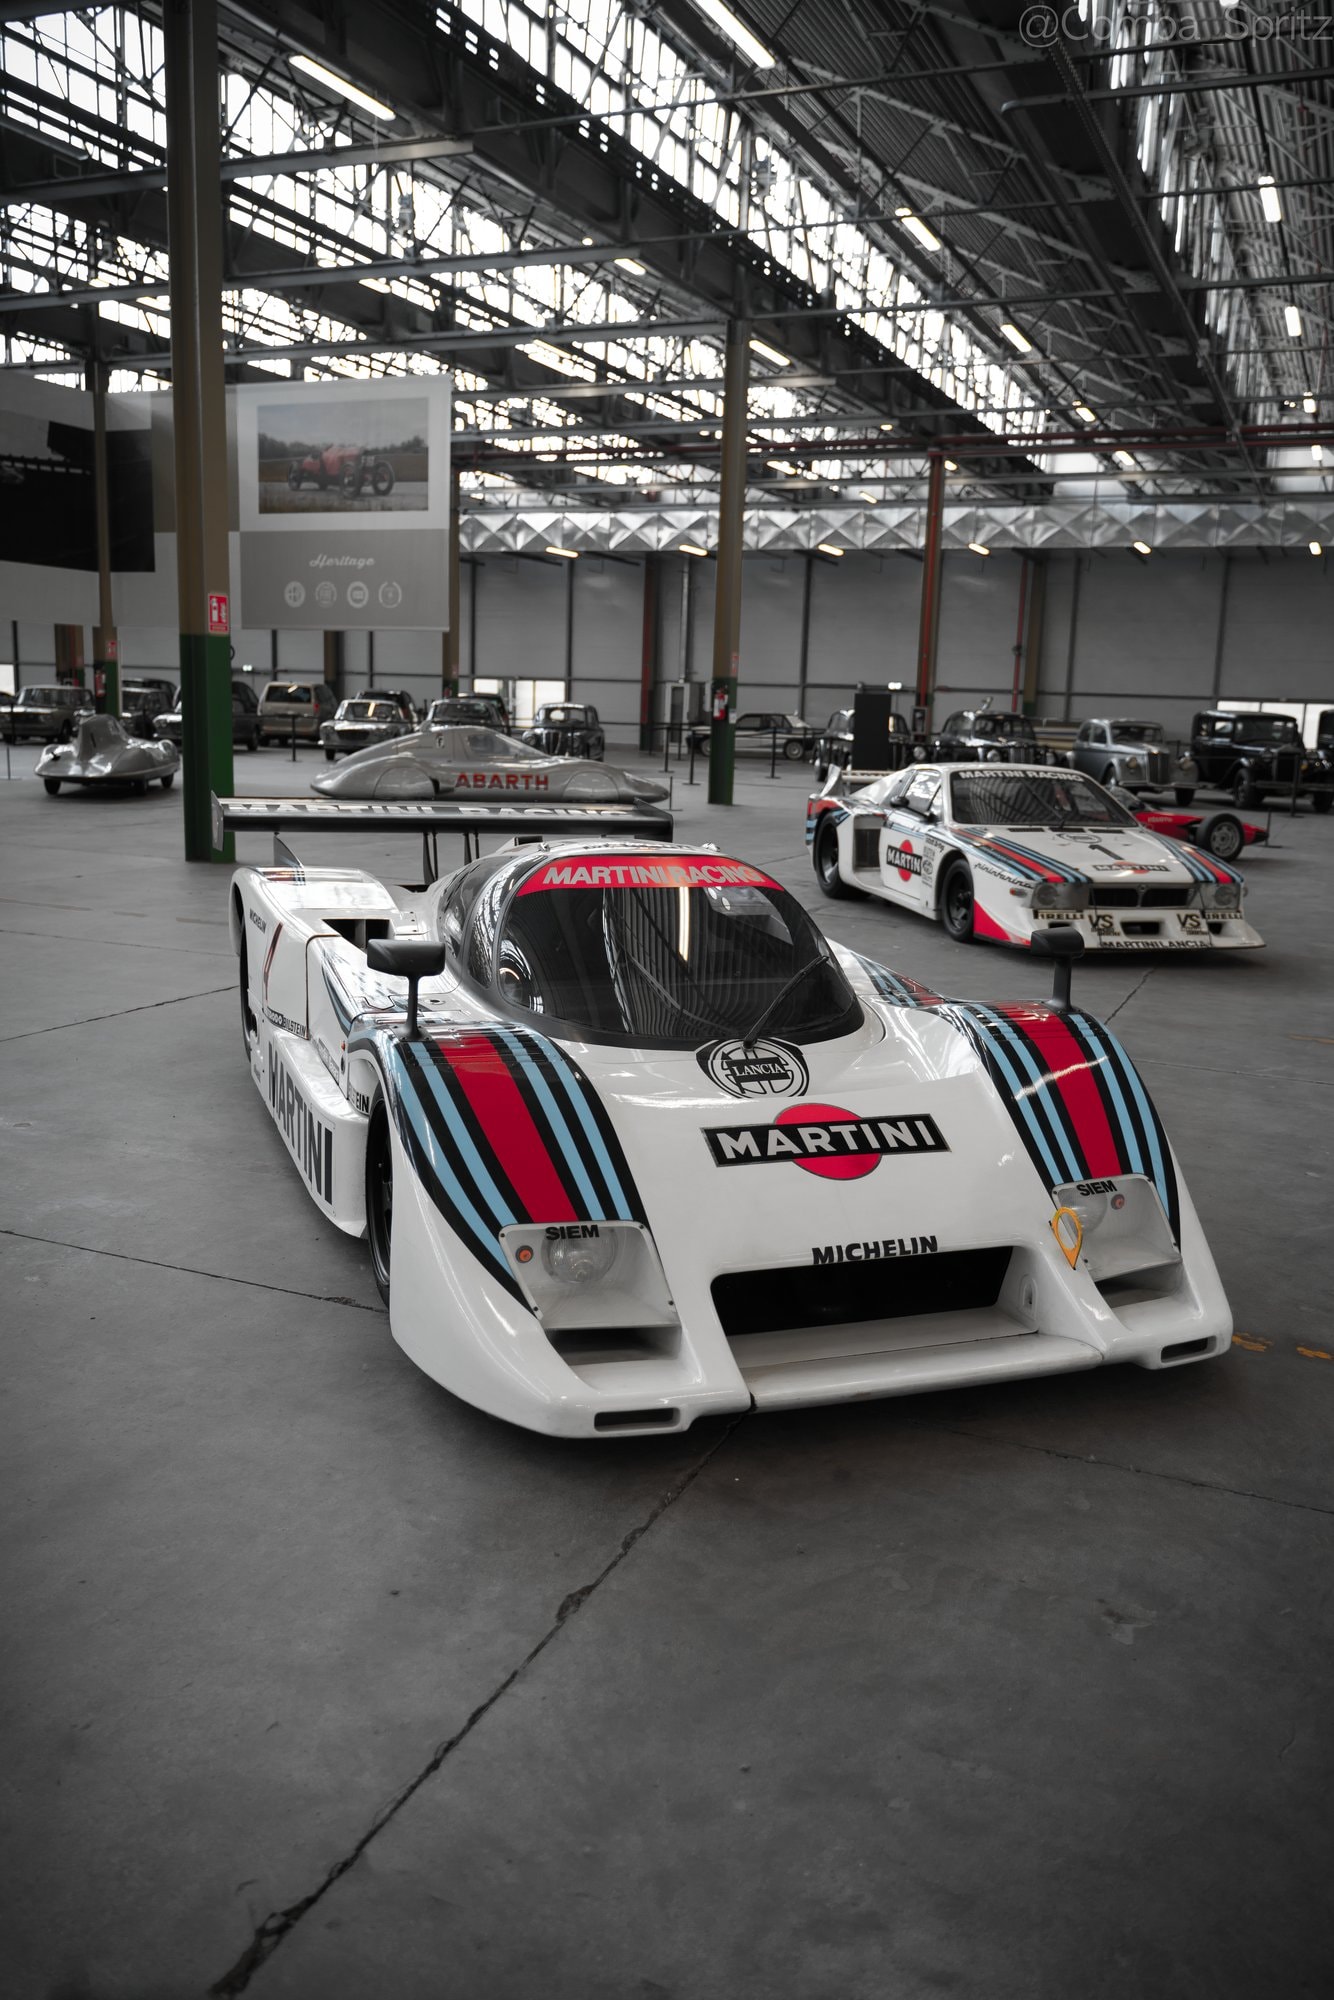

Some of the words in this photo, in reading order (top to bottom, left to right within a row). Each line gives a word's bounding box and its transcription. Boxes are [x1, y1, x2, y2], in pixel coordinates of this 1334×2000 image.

[309, 553, 375, 570] Heritage
[455, 772, 549, 791] ABARTH
[959, 771, 1024, 780] MARTINI
[1025, 771, 1084, 781] RACING
[543, 865, 669, 885] MARTINI
[669, 865, 767, 885] RACING
[732, 1063, 786, 1077] LANCIA
[268, 1040, 333, 1206] MARTINI
[716, 1120, 936, 1160] MARTINI
[1076, 1180, 1118, 1197] SIEM
[545, 1224, 600, 1241] SIEM
[811, 1235, 939, 1265] MICHELIN
